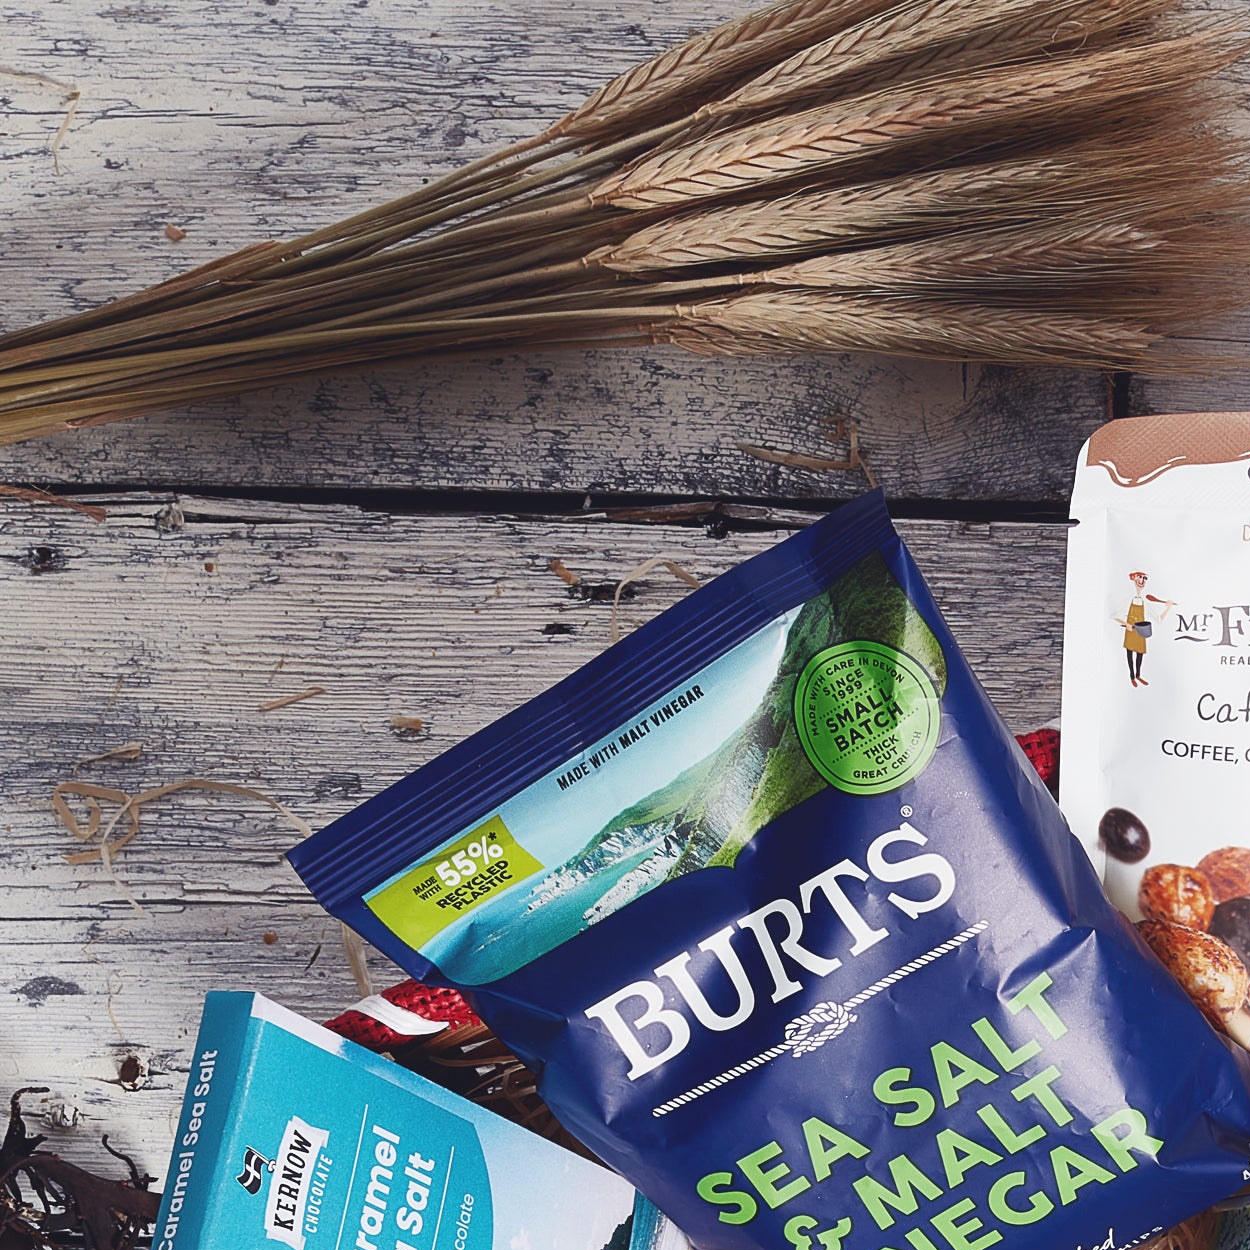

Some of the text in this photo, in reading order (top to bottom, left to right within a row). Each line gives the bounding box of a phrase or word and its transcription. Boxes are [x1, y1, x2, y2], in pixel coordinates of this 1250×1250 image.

[809, 657, 905, 736] MADE WITH CARE IN DEVON
[822, 668, 865, 697] SINCE
[831, 680, 863, 702] 1999
[826, 687, 893, 734] SMALL
[833, 701, 904, 753] BATCH
[556, 684, 705, 791] MADE WITH MALT VINEGAR
[853, 731, 922, 779] GREAT CRUNCH
[863, 734, 900, 760] THICK
[875, 747, 899, 765] CUT
[1161, 739, 1239, 764] COFFEE,
[412, 875, 438, 896] MADE
[418, 884, 442, 902] WITH
[436, 859, 509, 910] RECYCLED
[452, 870, 513, 911] PLASTIC
[194, 1049, 219, 1099] Salt
[696, 972, 1073, 1225] SEA SALT
[182, 1101, 207, 1147] Sea
[852, 1065, 1073, 1230] MALT
[273, 1130, 312, 1231] KERNOW
[305, 1154, 333, 1233] CHOCOLATE
[396, 1151, 436, 1235] Salt
